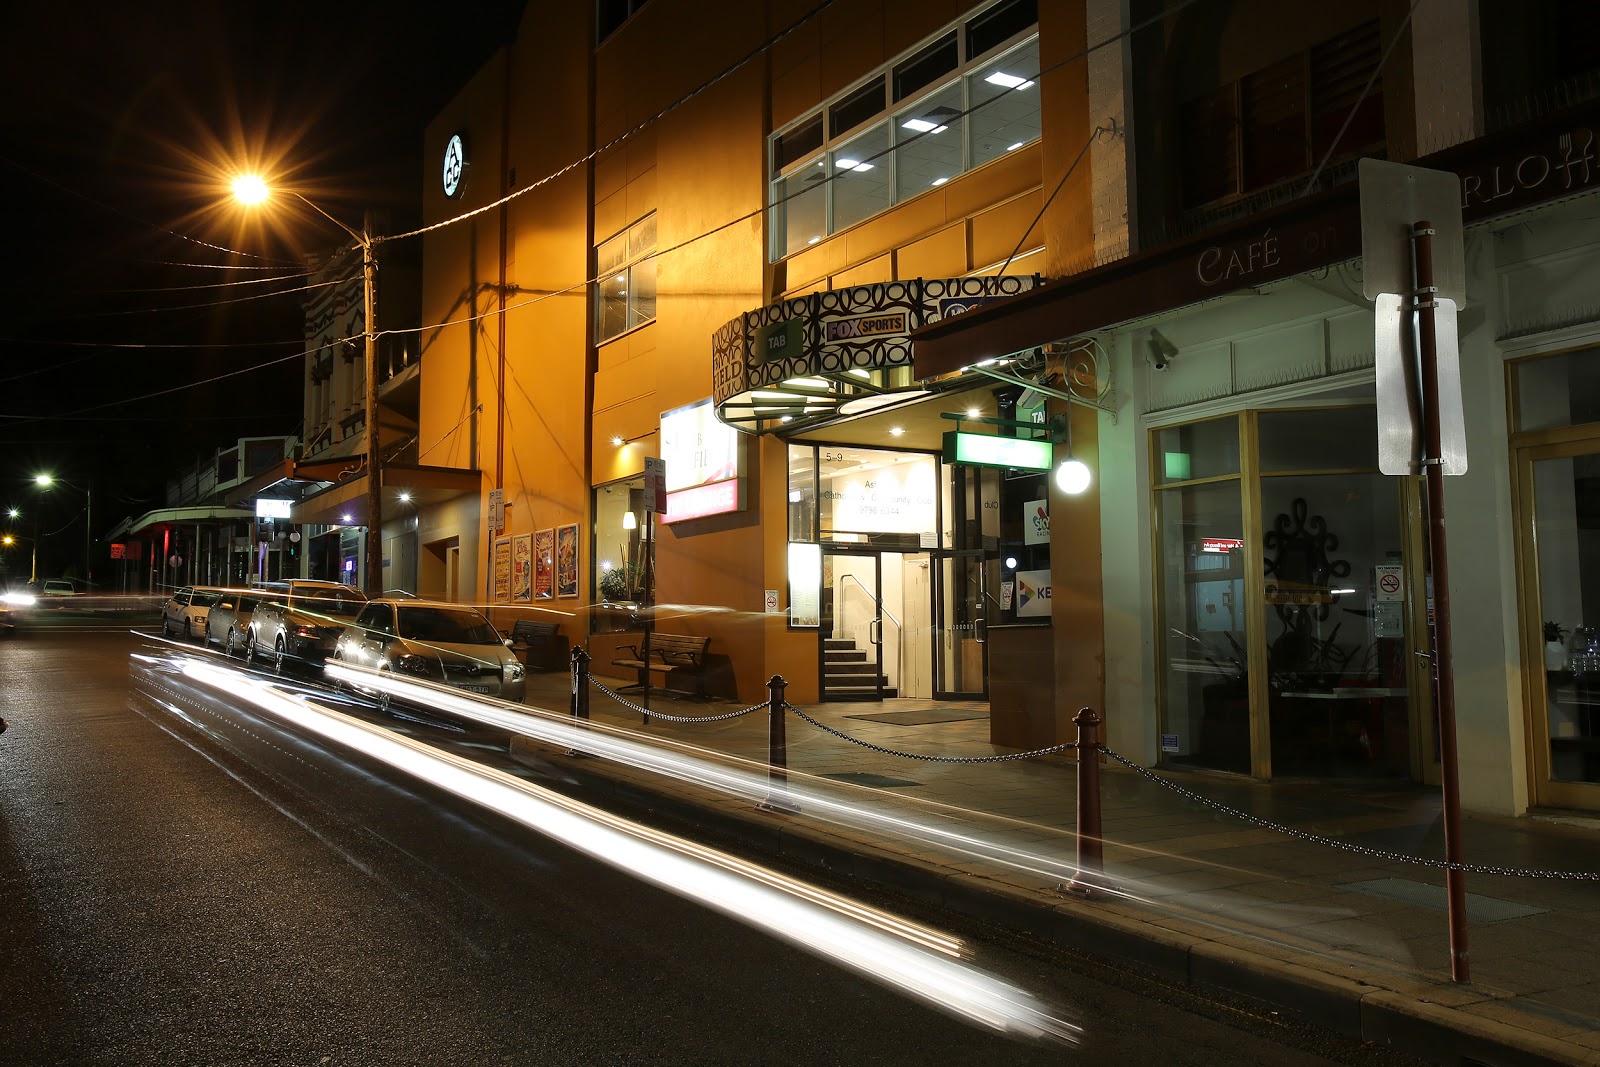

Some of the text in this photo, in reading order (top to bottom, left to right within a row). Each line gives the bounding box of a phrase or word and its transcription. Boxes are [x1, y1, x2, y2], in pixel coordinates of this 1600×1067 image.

[1197, 227, 1281, 286] CAFÉ
[827, 317, 901, 340] FOX SPORTS
[768, 334, 786, 349] TAB
[1032, 411, 1045, 423] TA
[1037, 587, 1052, 599] KE
